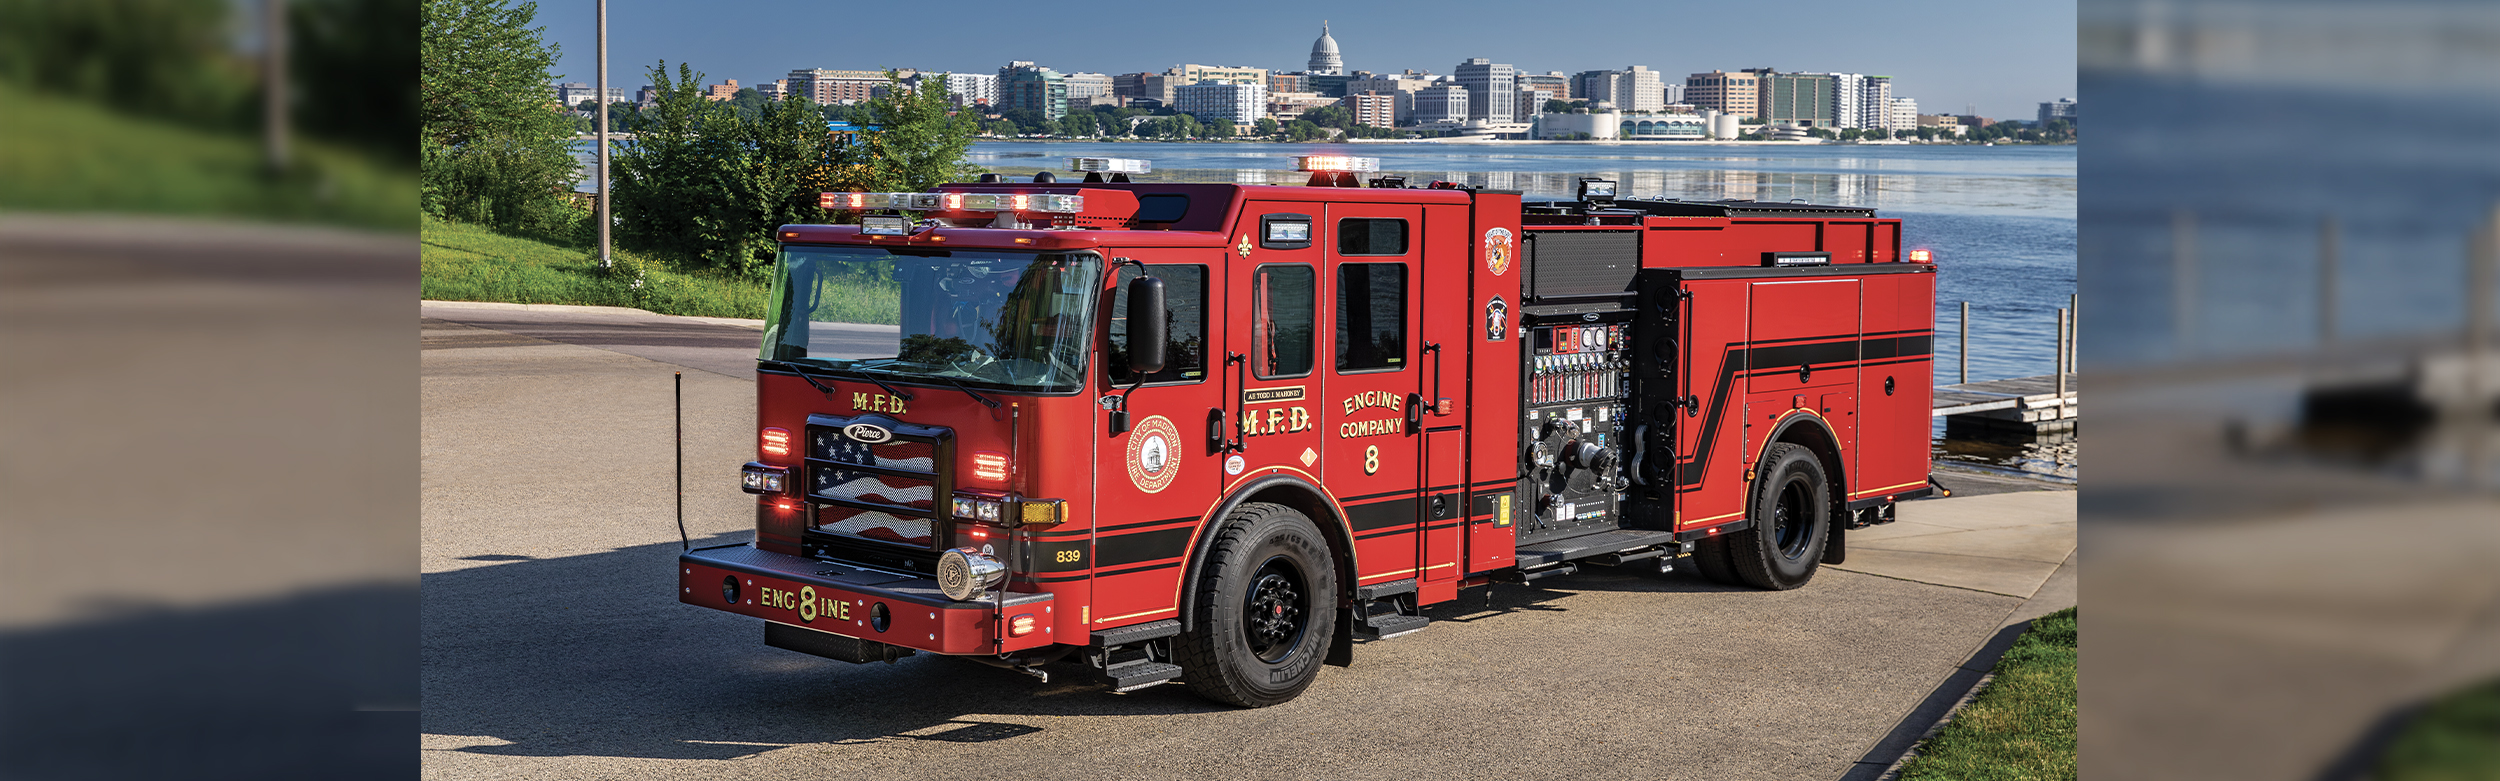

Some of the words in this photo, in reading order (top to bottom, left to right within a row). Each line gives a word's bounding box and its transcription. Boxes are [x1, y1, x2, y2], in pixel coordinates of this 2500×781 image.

[852, 391, 907, 415] M.F.D.
[1343, 390, 1402, 416] ENGINE
[854, 426, 881, 439] Pierce
[1130, 430, 1142, 451] CITY
[1141, 421, 1151, 432] OF
[1152, 419, 1178, 447] MADISON
[1340, 417, 1403, 438] COMPANY
[1130, 459, 1141, 480] FIRE
[1140, 457, 1178, 489] DEPARTMENT
[1364, 444, 1379, 476] 8
[1056, 549, 1081, 563] 839
[798, 585, 817, 623] 8
[1270, 631, 1321, 683] MICHELIN
